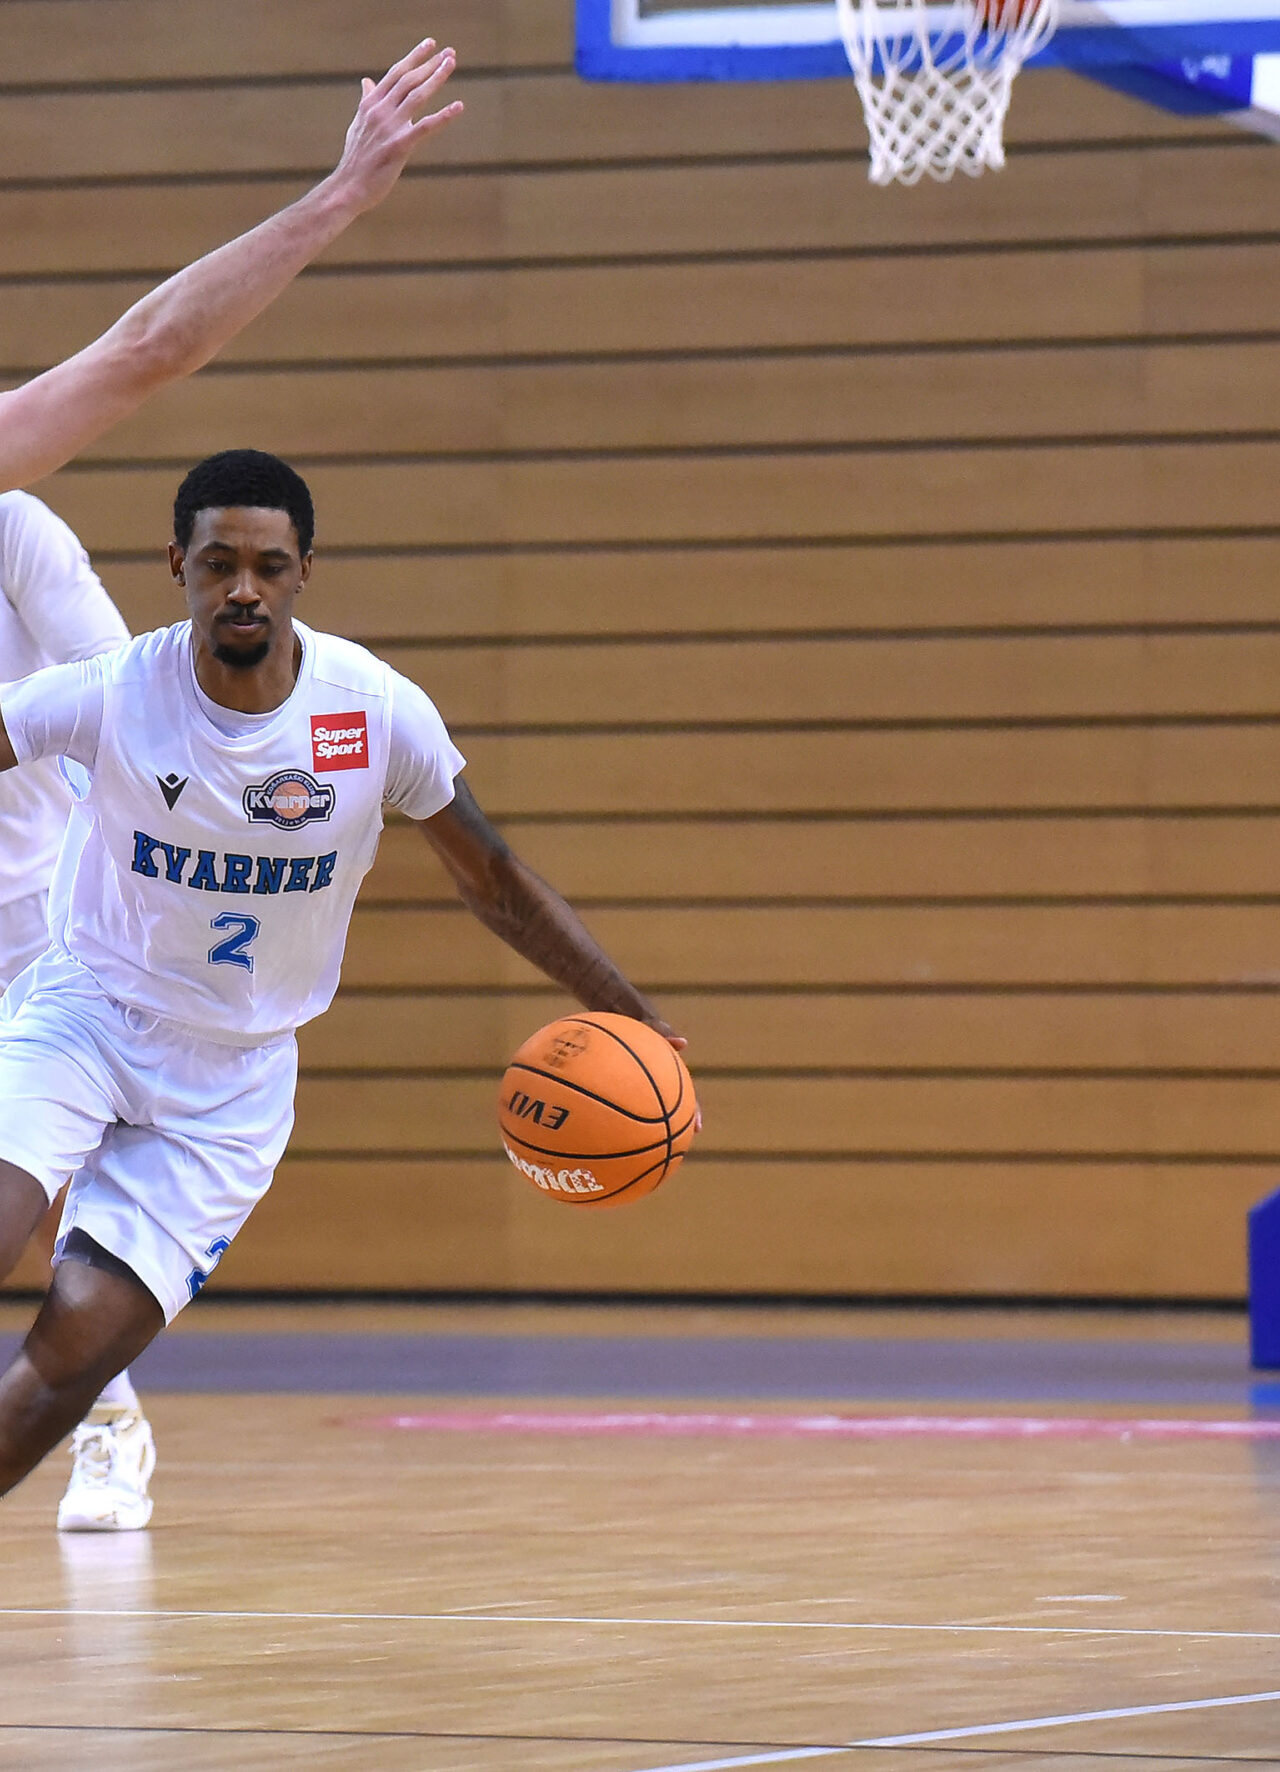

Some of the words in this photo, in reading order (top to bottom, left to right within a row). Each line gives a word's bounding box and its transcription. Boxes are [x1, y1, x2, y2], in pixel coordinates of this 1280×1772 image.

[312, 727, 366, 743] Super
[315, 740, 364, 759] Sport
[249, 791, 331, 809] Kvarner
[131, 830, 338, 895] KVARNER
[207, 911, 261, 974] 2
[503, 1140, 605, 1194] Wilso
